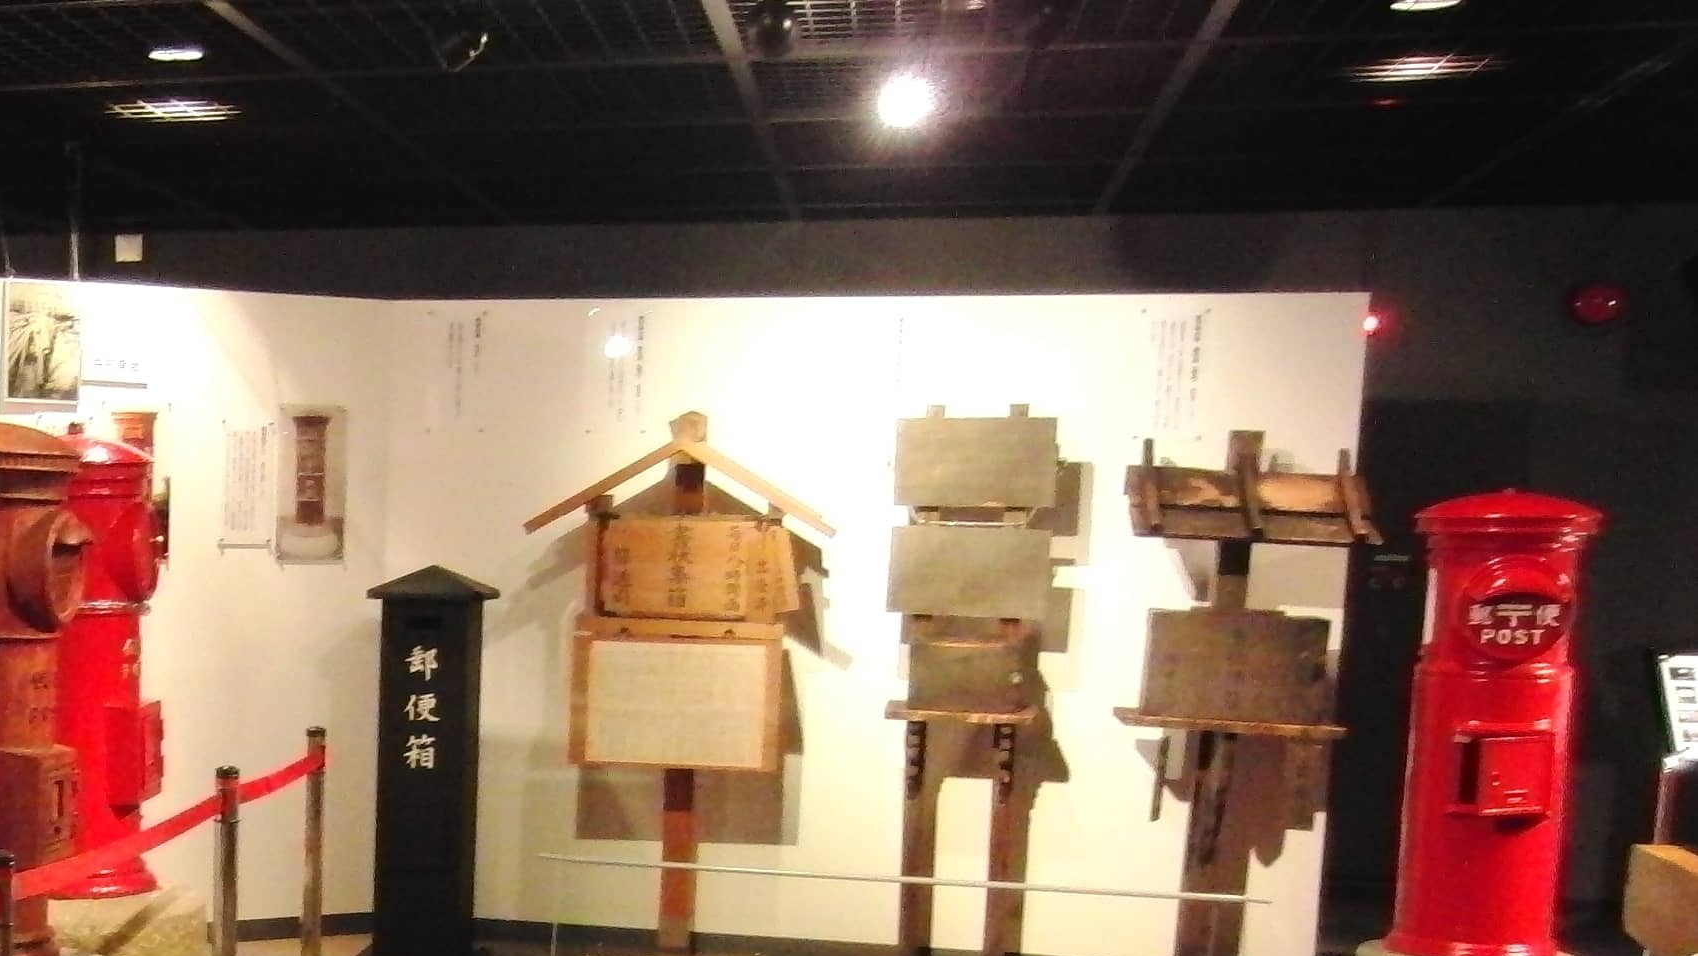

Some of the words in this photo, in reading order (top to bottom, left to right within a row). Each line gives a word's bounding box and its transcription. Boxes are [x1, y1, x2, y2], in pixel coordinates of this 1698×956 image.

[1480, 628, 1546, 645] POST
[403, 645, 441, 769] 郵便箱
